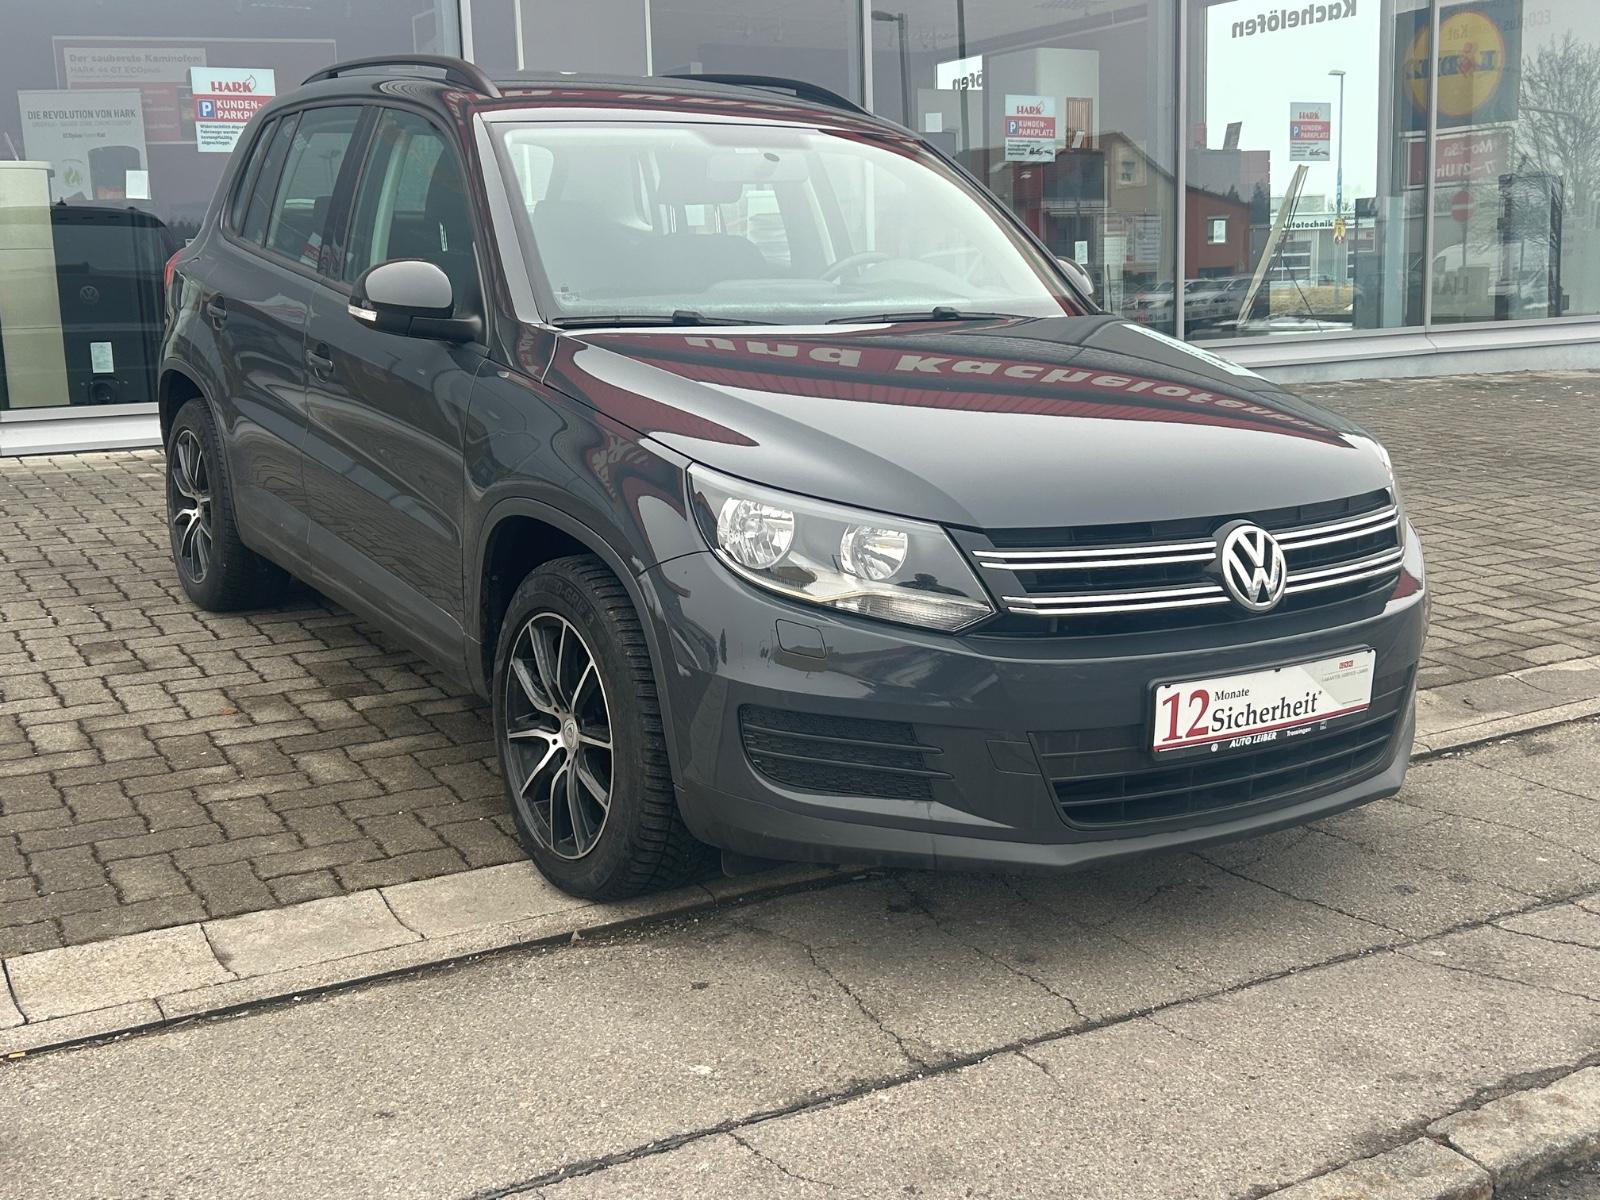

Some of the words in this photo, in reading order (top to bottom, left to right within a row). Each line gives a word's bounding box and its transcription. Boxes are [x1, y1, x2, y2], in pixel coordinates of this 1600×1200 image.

[210, 81, 252, 93] HARK
[216, 100, 263, 109] KUNDEN-
[1016, 105, 1042, 115] HARK
[27, 110, 41, 120] DIE
[43, 110, 94, 120] REVOLUTION
[95, 109, 112, 119] VON
[113, 109, 136, 119] HARK
[1284, 219, 1334, 229] totechnik
[1162, 689, 1210, 742] 12
[1214, 688, 1250, 702] Monate
[1229, 736, 1252, 748] AUTO
[1252, 732, 1277, 745] LEIBER
